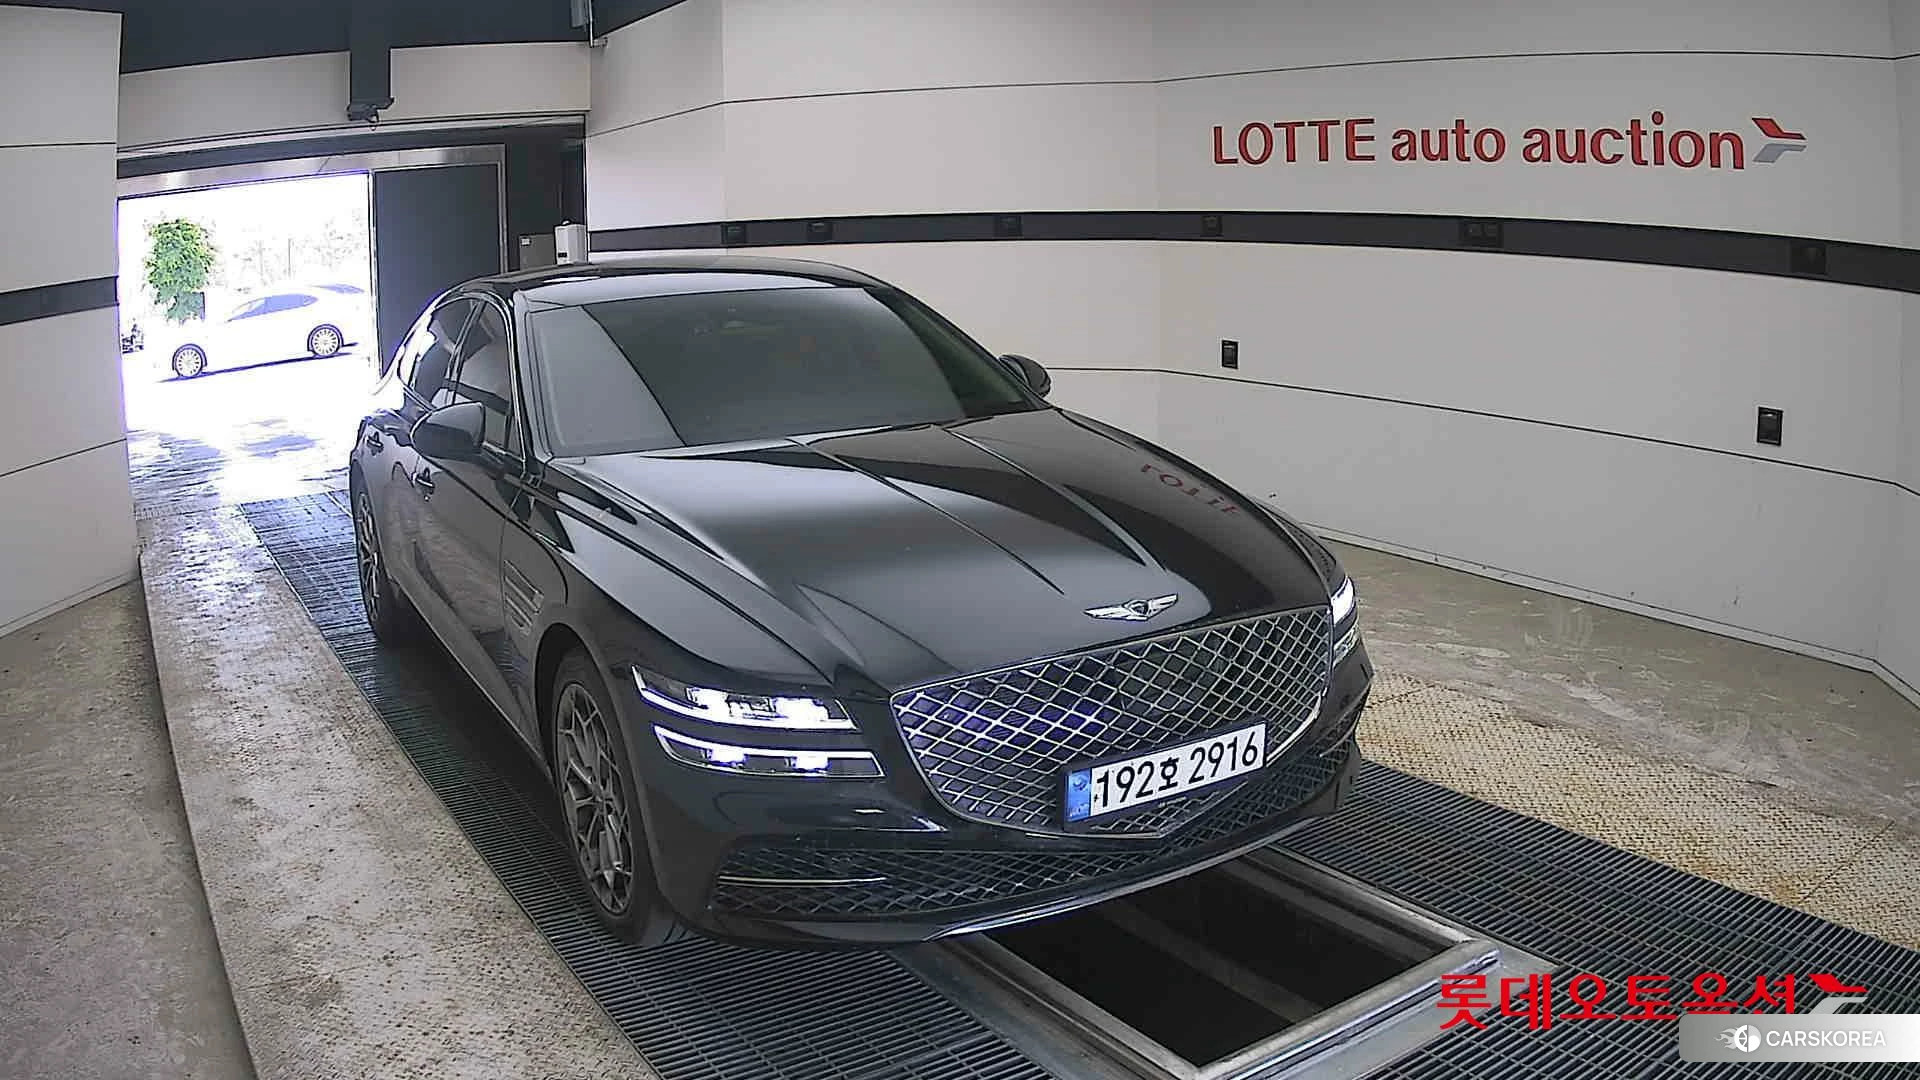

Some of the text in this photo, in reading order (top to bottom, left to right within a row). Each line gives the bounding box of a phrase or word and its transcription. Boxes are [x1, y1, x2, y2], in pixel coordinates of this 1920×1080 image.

[1212, 110, 1745, 169] LOTTE auto auction
[1095, 730, 1260, 809] 192호 2916
